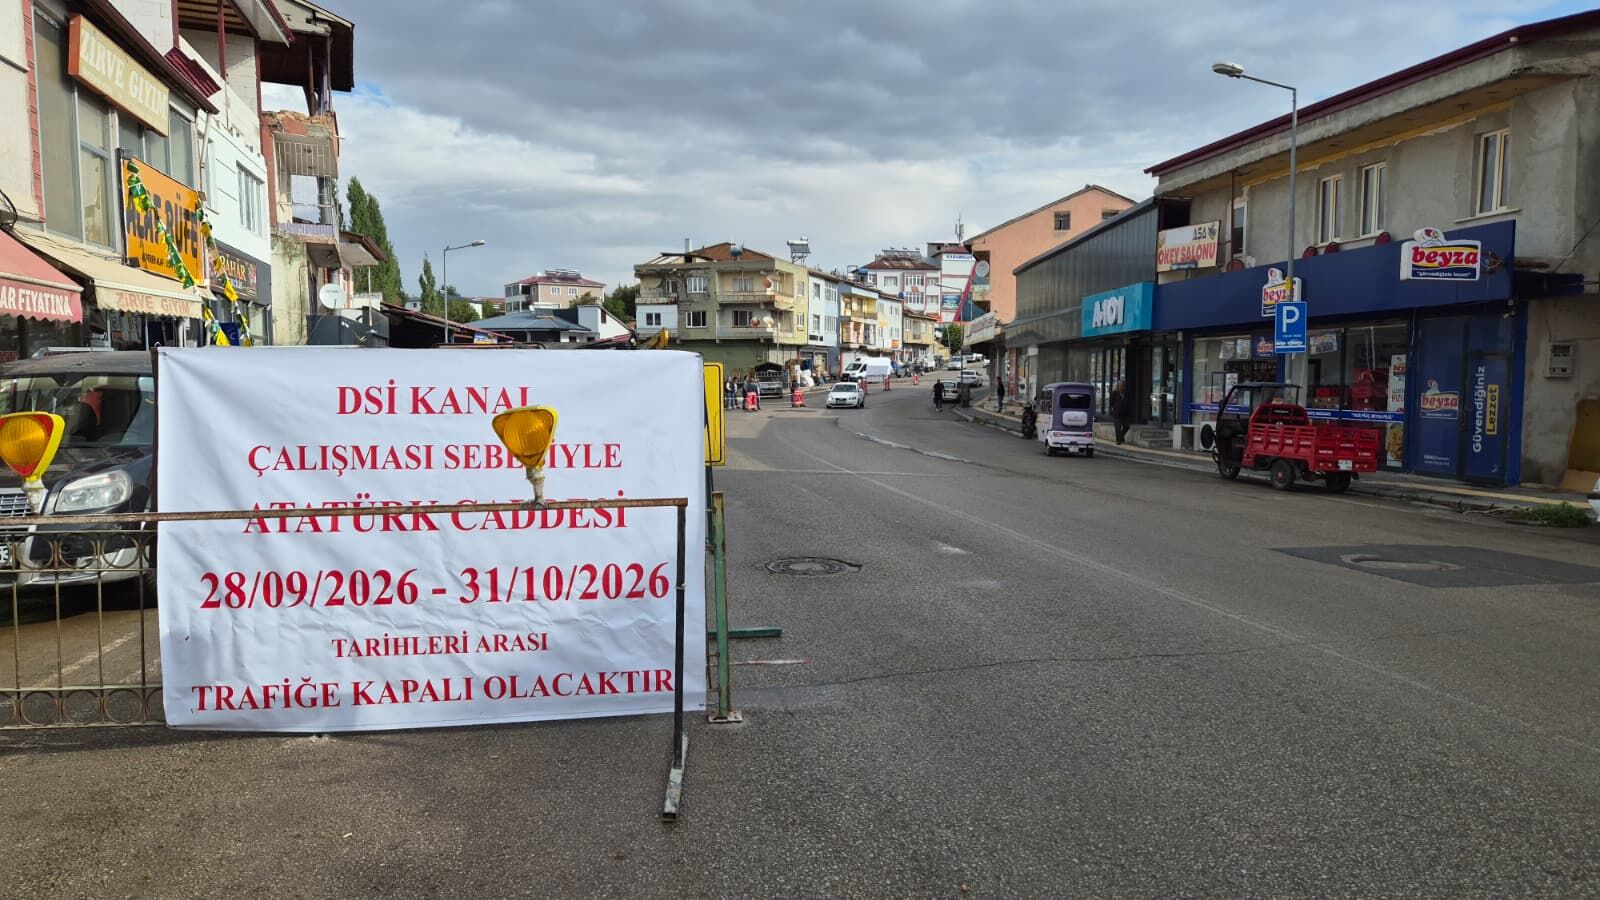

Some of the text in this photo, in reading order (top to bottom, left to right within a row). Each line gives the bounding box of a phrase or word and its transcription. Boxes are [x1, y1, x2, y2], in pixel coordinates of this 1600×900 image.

[1158, 242, 1216, 265] OKEY SALONU
[1411, 245, 1478, 268] beyza
[18, 288, 73, 317] FİYATINA
[1263, 287, 1288, 303] beyz
[1282, 305, 1300, 333] P
[336, 379, 398, 415] DSİ
[1472, 366, 1487, 453] Güvendiğiniz
[1486, 386, 1497, 433] Lezzet
[248, 438, 623, 478] ÇALIŞMASI SEBİYLE
[243, 489, 628, 534] ATATÜRK CADDESİ
[200, 568, 418, 609] 28/09/2026
[459, 562, 670, 604] 31/10/2026
[331, 631, 550, 658] TARİHLERİ ARASI
[191, 668, 674, 711] TRAFİĞE KAPALI OLACAKTIR
